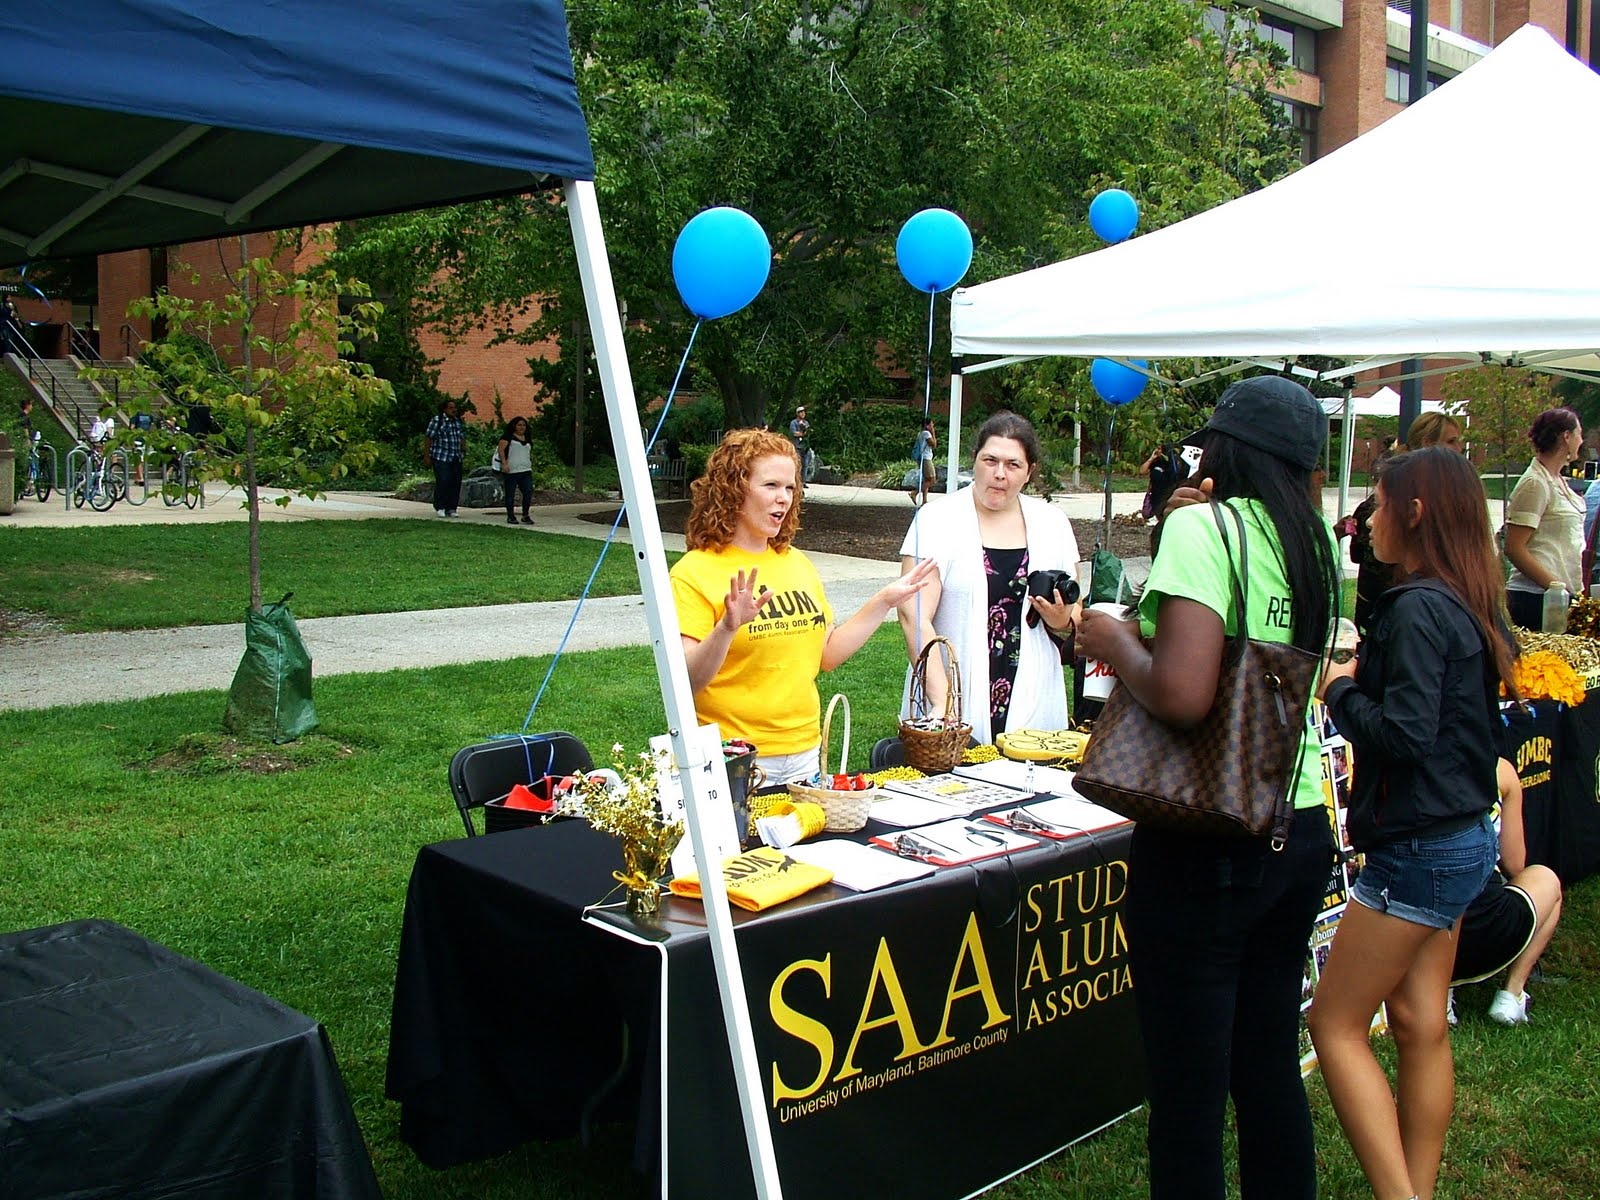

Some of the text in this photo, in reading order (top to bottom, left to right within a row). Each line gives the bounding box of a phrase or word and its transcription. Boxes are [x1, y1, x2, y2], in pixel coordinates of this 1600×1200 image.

[748, 618, 809, 634] from day one
[1265, 596, 1293, 629] RE
[1517, 736, 1552, 774] UMBC
[707, 789, 718, 801] TO
[769, 911, 1011, 1108] SAA
[780, 1027, 1009, 1123] University of Maryland, Baltimore County
